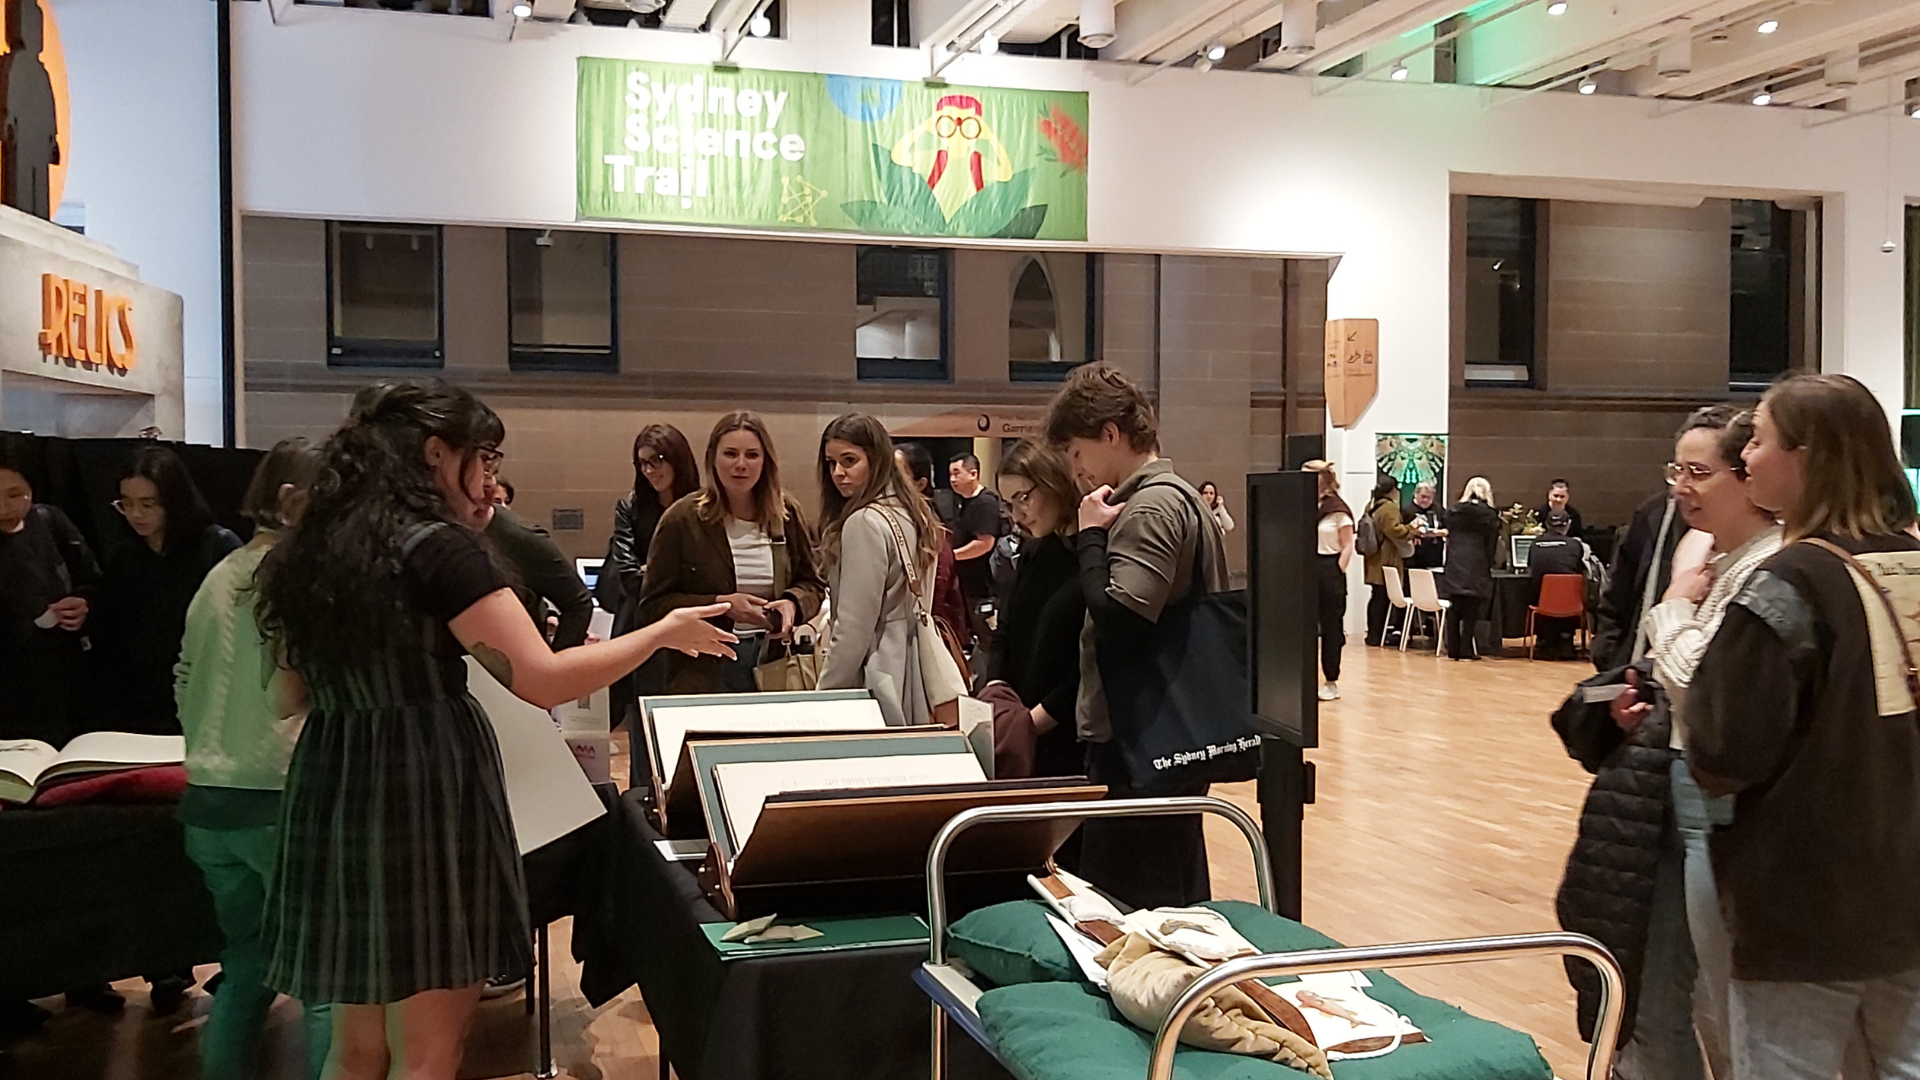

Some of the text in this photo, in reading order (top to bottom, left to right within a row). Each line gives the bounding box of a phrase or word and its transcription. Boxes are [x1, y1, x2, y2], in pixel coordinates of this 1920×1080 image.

[625, 71, 789, 128] Sydney
[624, 113, 805, 161] Science
[604, 155, 708, 209] Trail
[39, 273, 137, 371] RELICS
[1152, 734, 1262, 770] The Sydney Morning Herald
